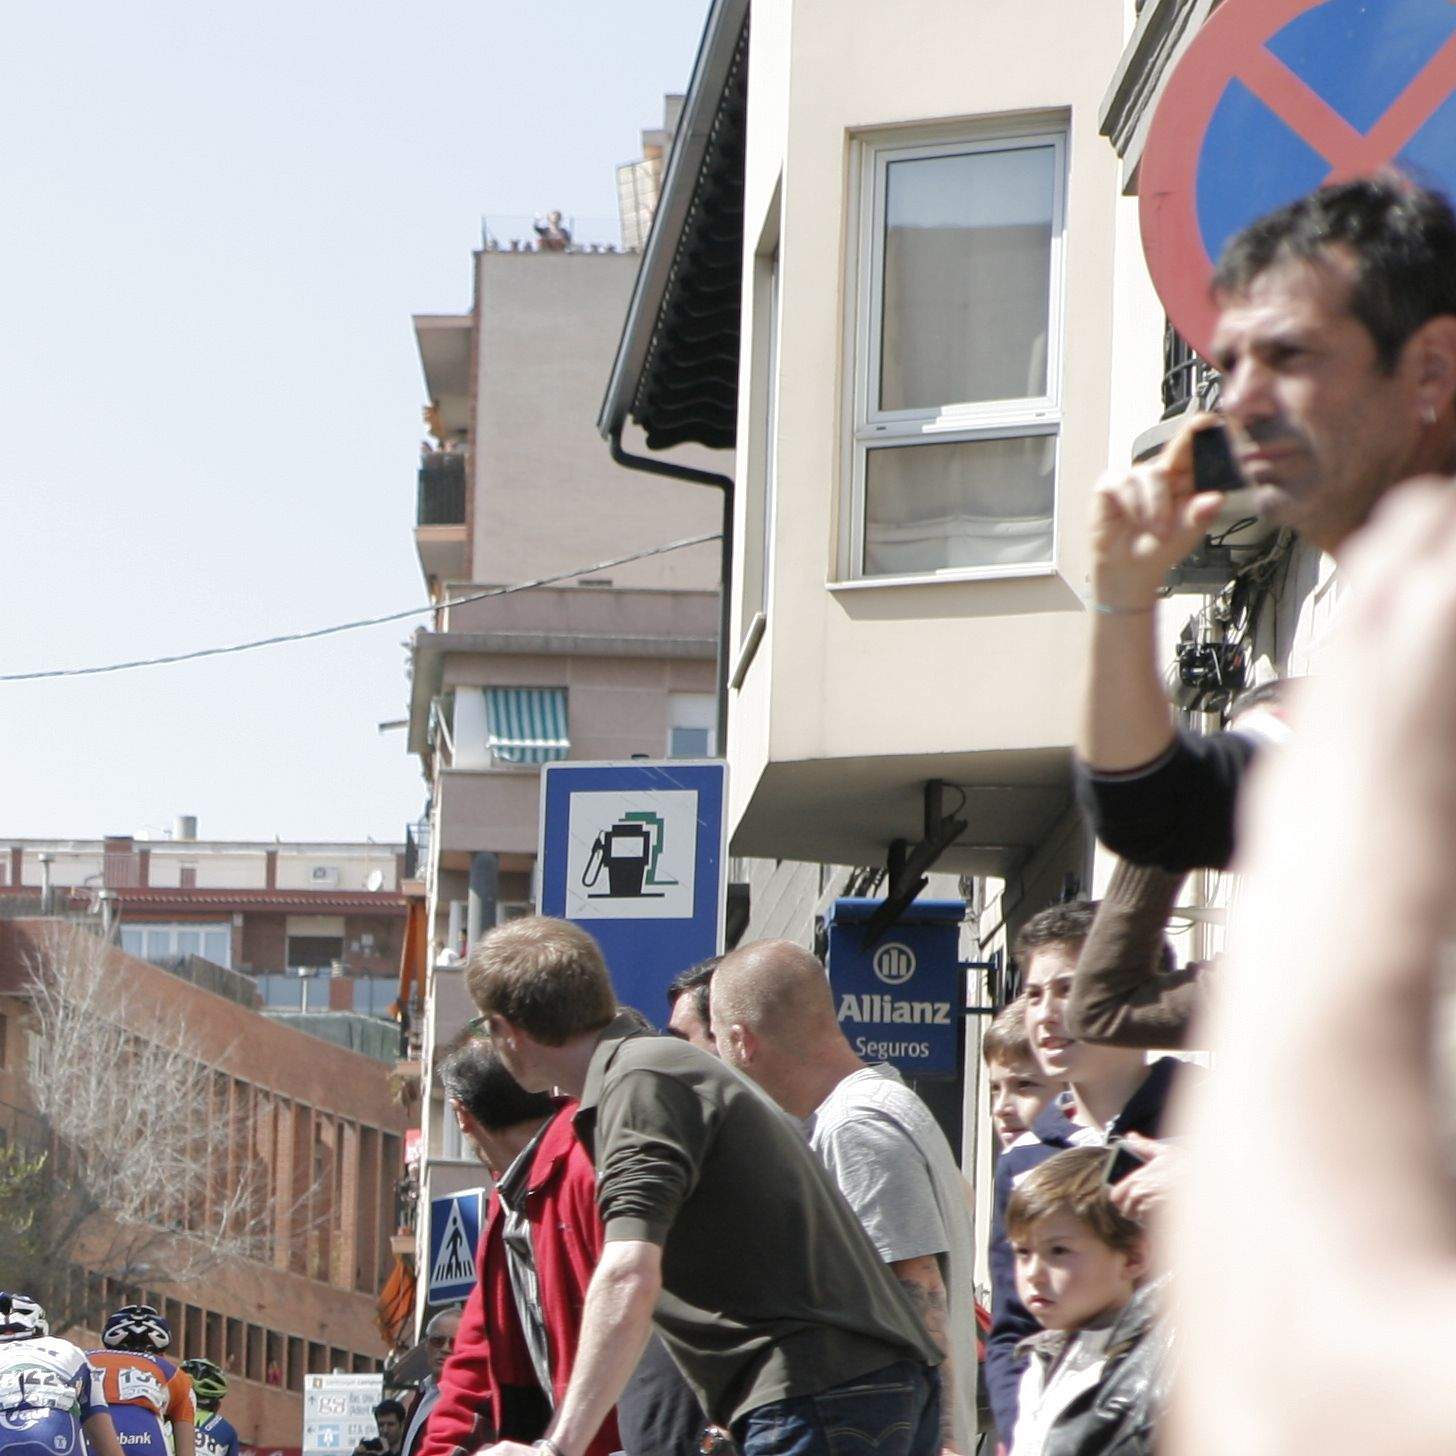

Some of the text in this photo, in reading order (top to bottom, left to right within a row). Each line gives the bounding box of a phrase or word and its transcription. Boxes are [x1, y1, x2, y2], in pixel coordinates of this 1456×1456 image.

[839, 994, 951, 1025] Allianz
[856, 1036, 930, 1060] Seguros
[118, 1432, 152, 1446] bank
